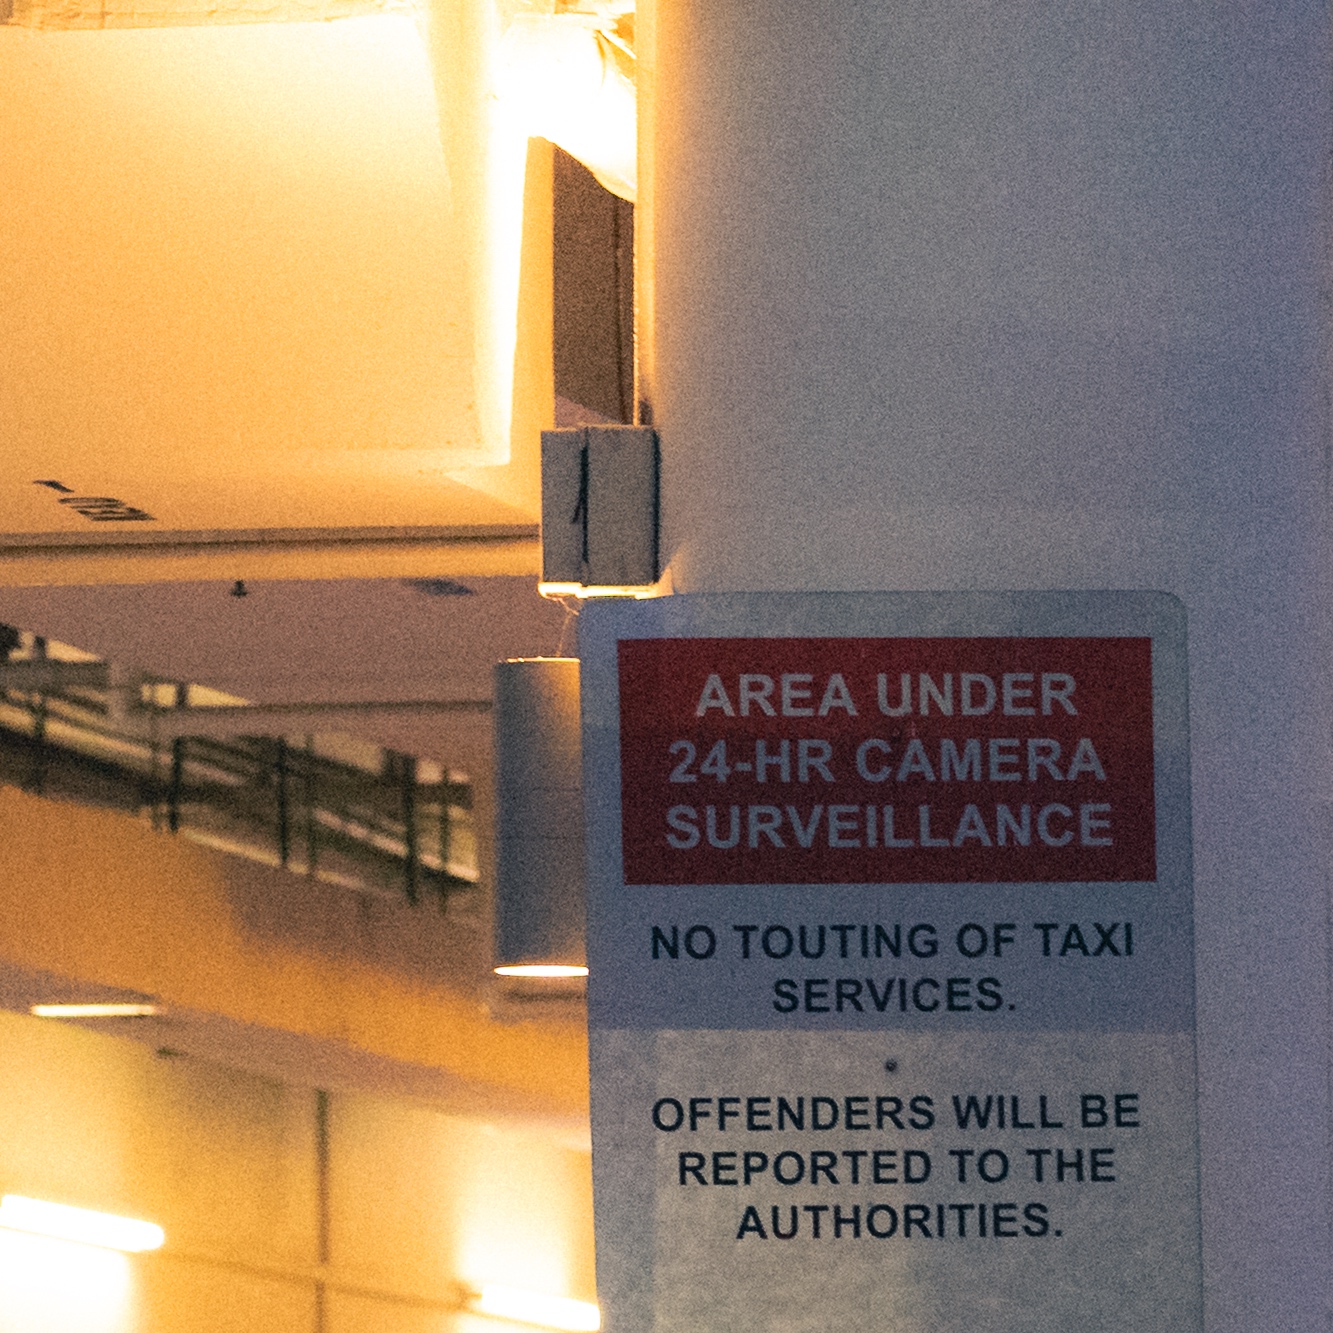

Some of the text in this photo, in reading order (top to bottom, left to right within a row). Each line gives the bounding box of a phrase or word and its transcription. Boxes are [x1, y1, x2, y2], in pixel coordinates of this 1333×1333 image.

[695, 672, 1078, 717] AREA UNDER
[668, 737, 1107, 783] 24-HR CAMERA
[665, 802, 1114, 849] SURVEILLANCE
[651, 922, 1134, 960] NO TOUTING OF TAXI
[773, 976, 1016, 1012] SERVICES.
[652, 1093, 1139, 1132] OFFENDERS WILL BE
[678, 1148, 1115, 1186] REPORTED TO THE
[736, 1202, 1062, 1240] AUTHORITIES.
